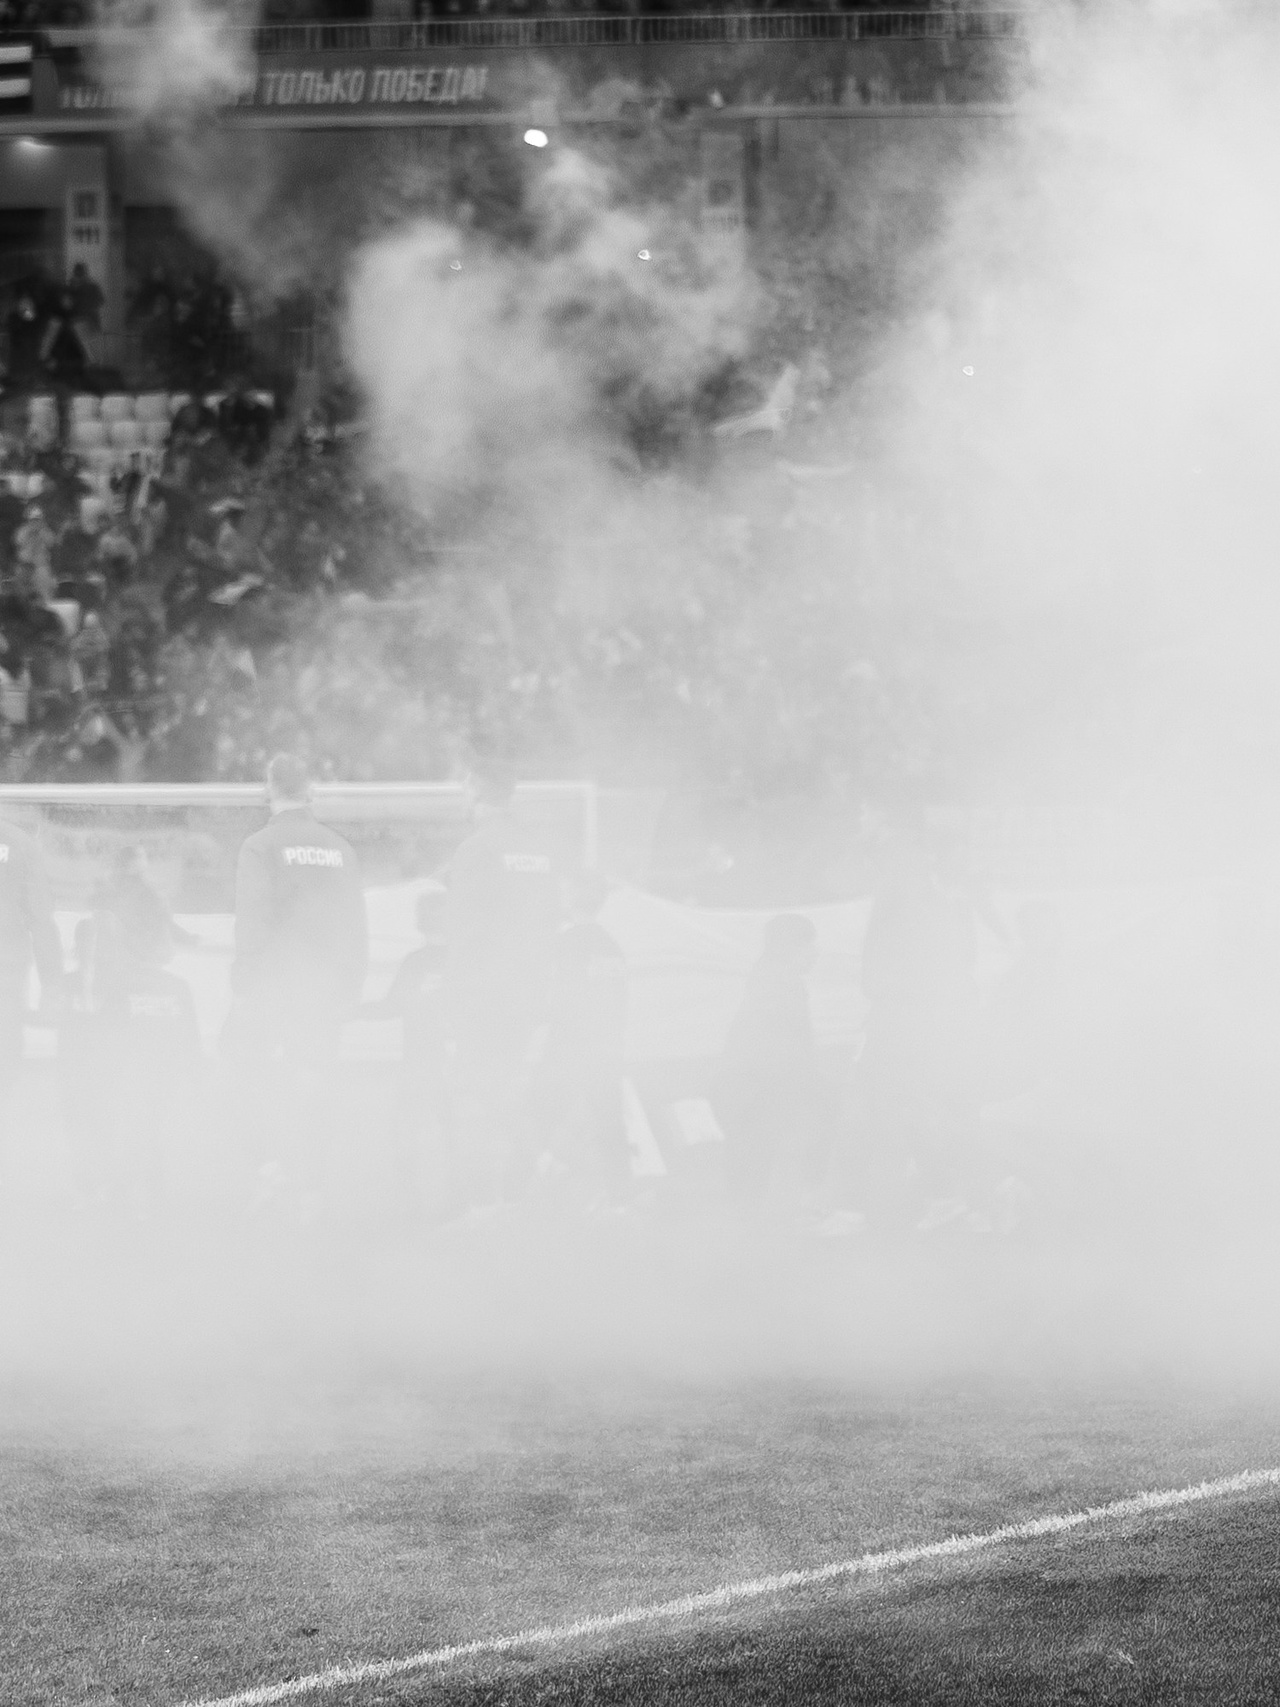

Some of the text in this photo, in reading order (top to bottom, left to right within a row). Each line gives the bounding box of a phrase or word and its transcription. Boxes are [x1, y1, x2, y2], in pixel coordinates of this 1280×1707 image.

[263, 69, 366, 104] ТОЛЬКО
[369, 66, 489, 104] ПОБЕДА!
[284, 846, 344, 867] РОССИЯ
